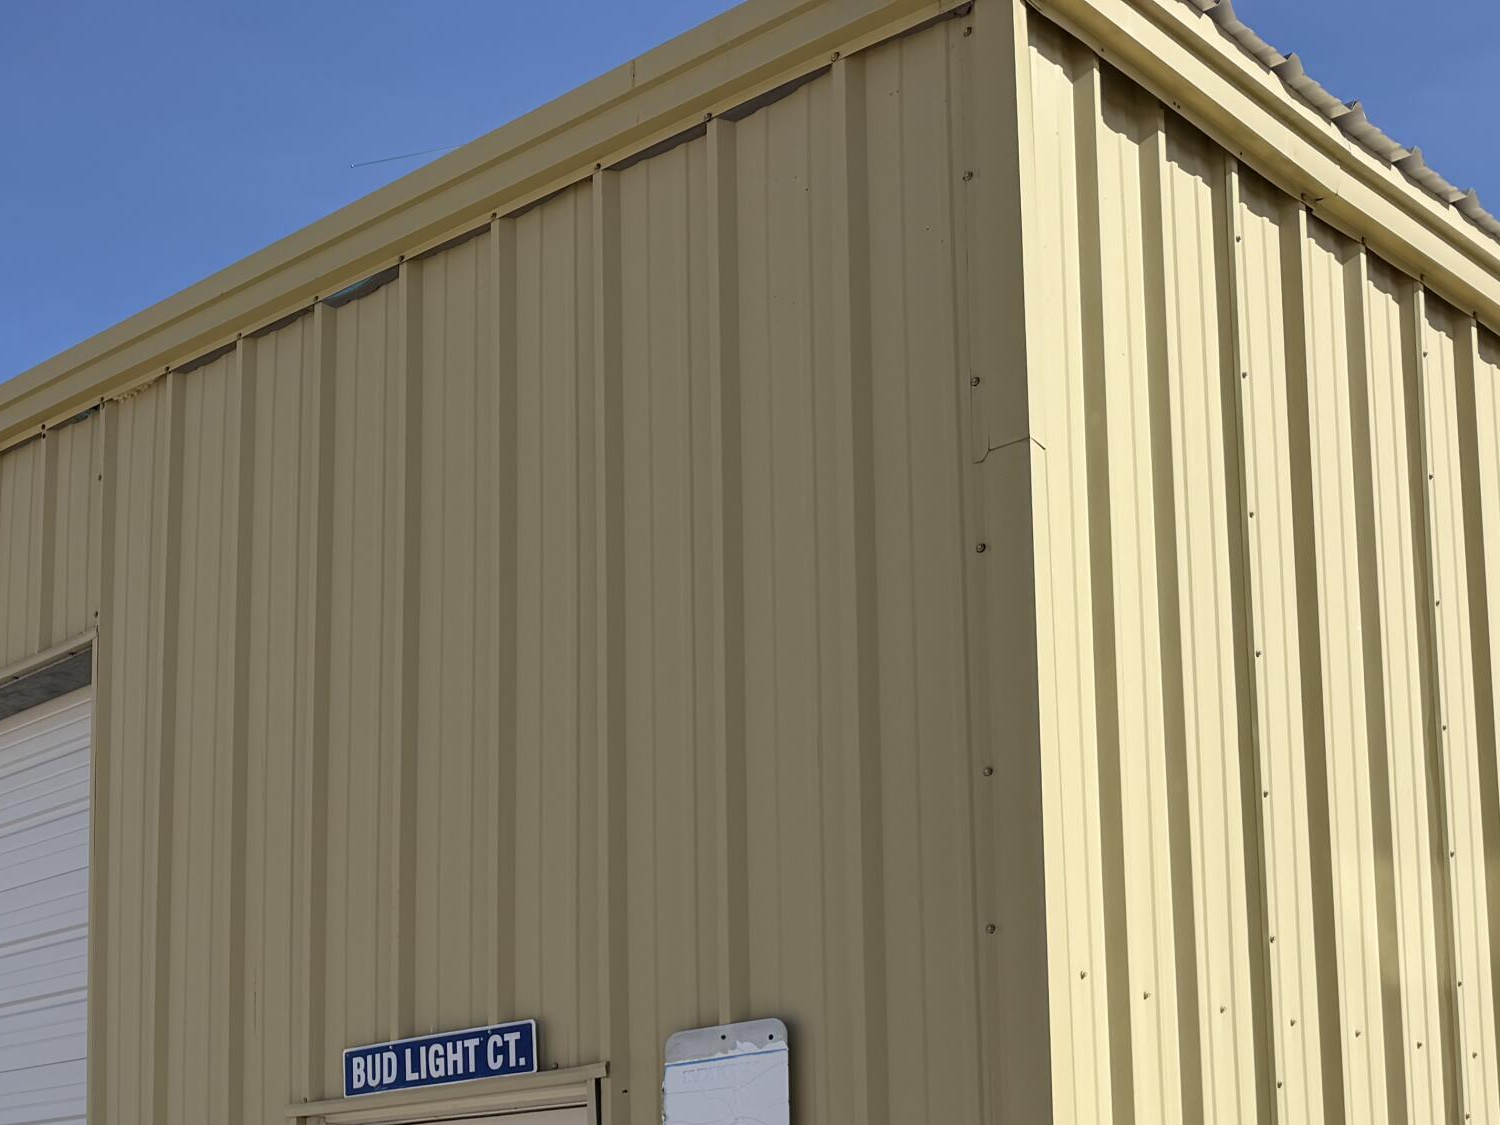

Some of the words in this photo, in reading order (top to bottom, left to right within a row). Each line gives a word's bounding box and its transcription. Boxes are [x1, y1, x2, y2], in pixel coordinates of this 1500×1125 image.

[352, 1051, 398, 1089] BUD
[404, 1037, 480, 1082] LIGHT
[486, 1031, 526, 1071] CT.
